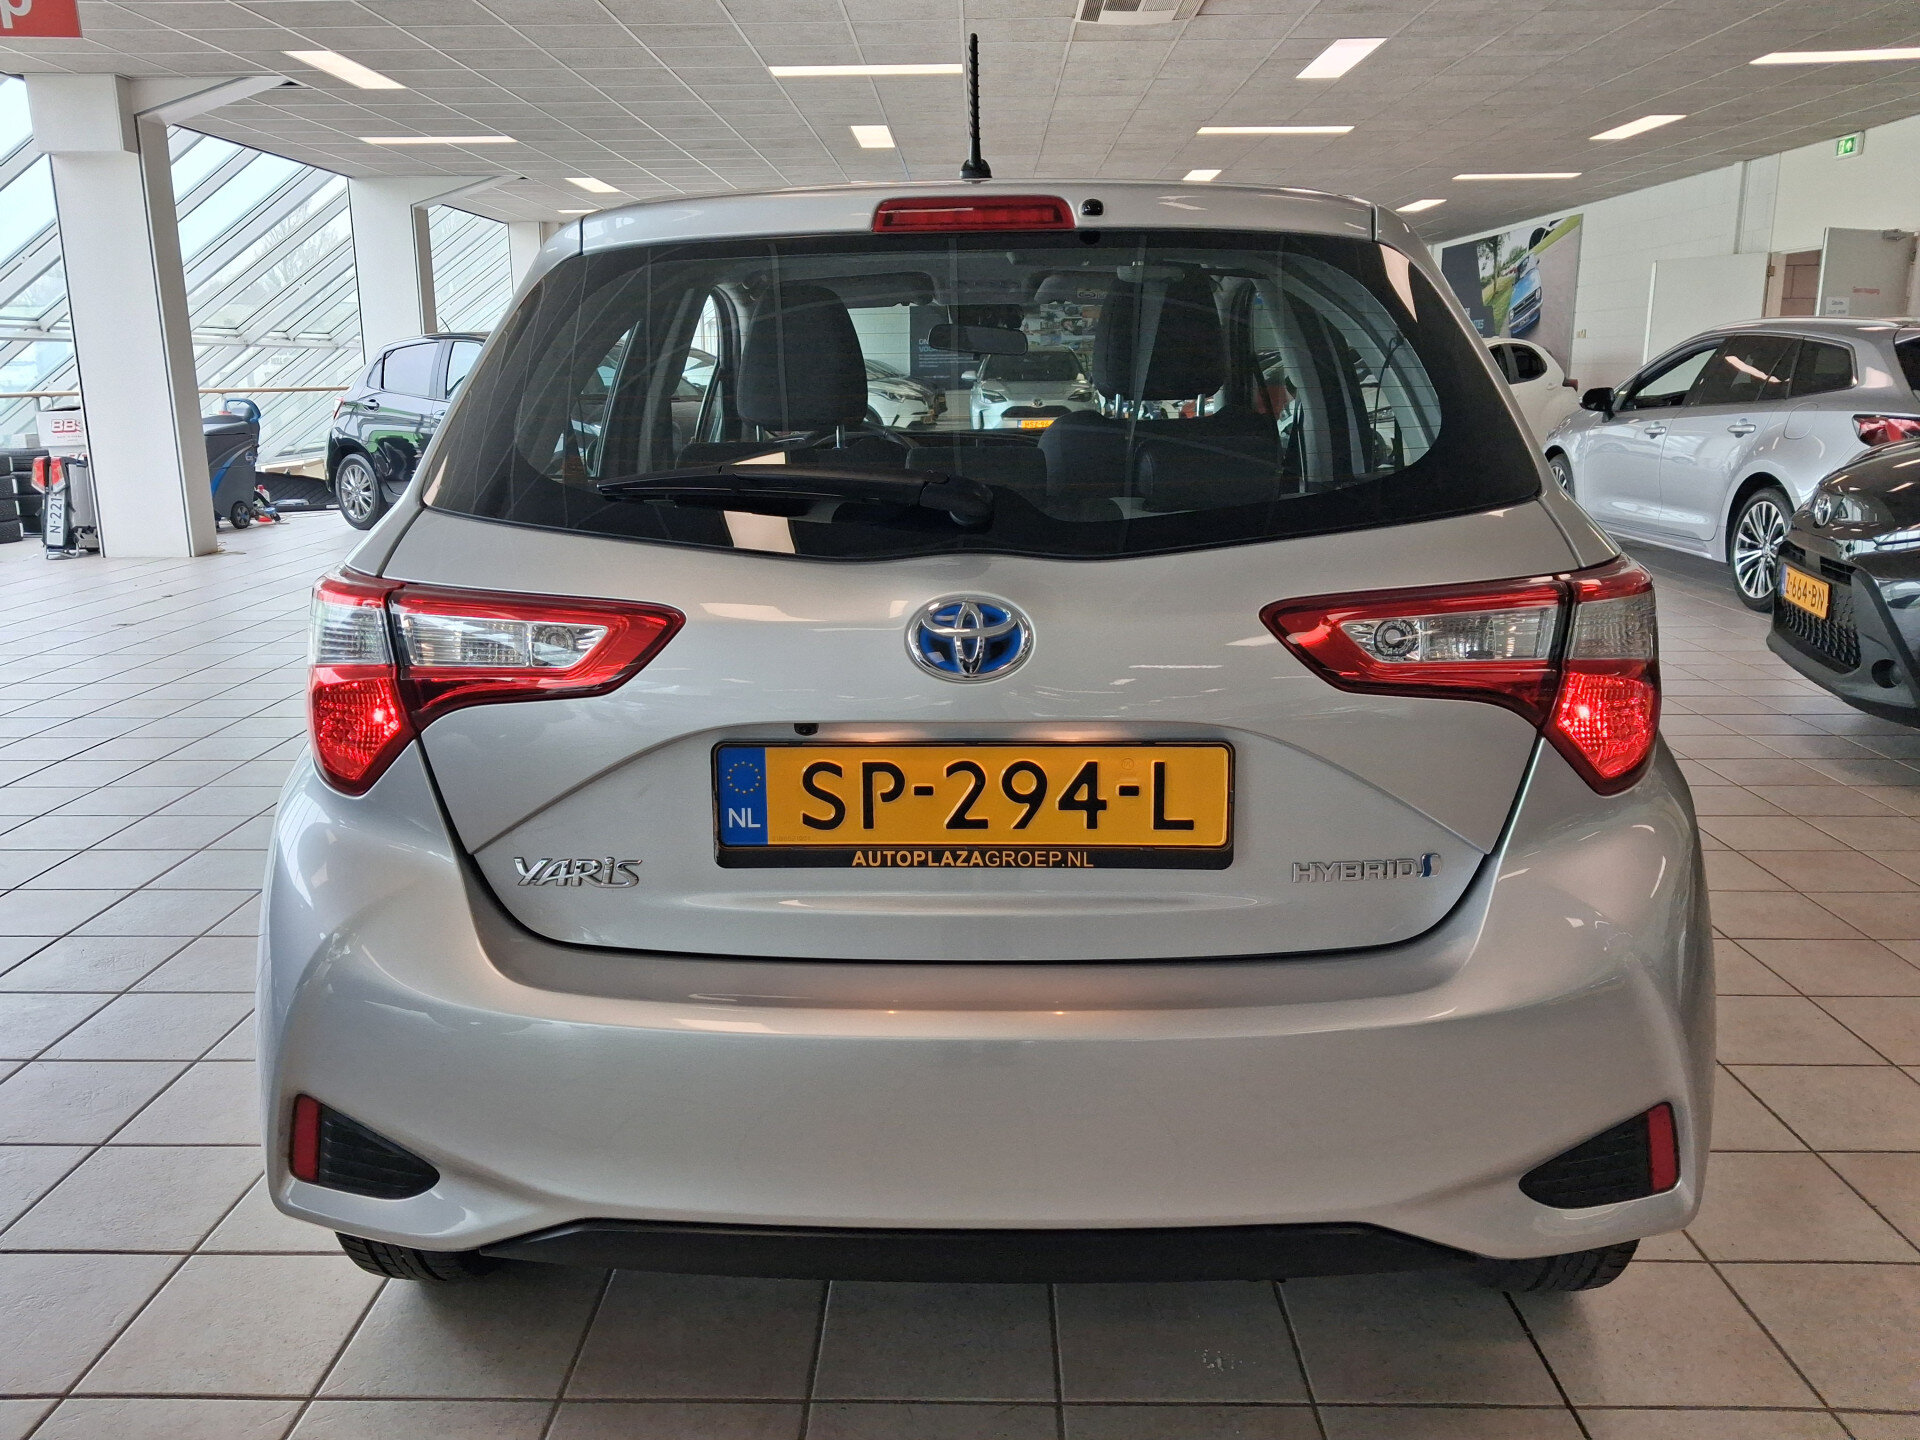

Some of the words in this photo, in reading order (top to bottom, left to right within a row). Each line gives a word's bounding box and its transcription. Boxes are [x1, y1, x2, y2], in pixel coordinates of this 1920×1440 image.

[1786, 572, 1825, 611] Z-664-BN
[802, 760, 1195, 831] SP-294-L
[728, 807, 761, 829] NL
[851, 850, 1094, 868] AUTOPLAZAGROEP.NL
[1292, 858, 1418, 883] HYBRID
